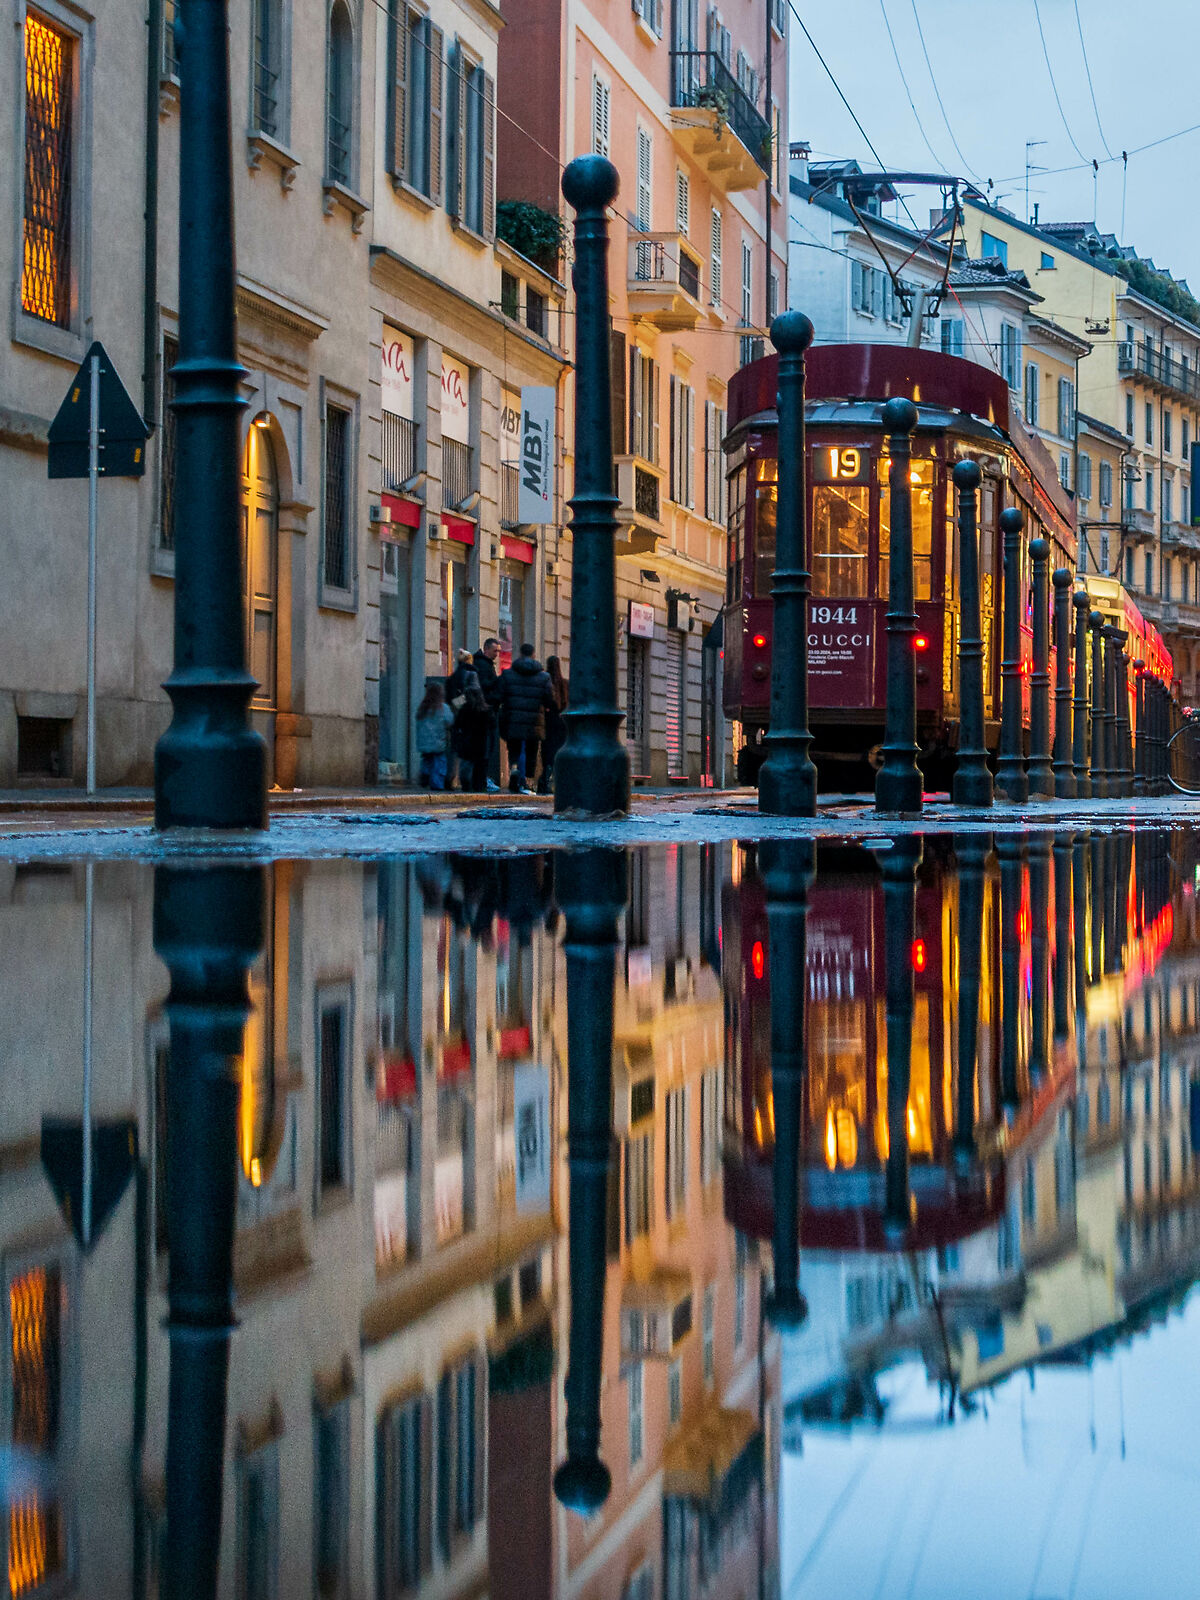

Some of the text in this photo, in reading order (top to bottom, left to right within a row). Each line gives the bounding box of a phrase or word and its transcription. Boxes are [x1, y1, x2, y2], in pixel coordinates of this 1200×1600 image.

[522, 409, 542, 497] MBT
[829, 448, 861, 478] 19
[811, 607, 857, 624] 1944
[807, 634, 870, 646] GUCCI
